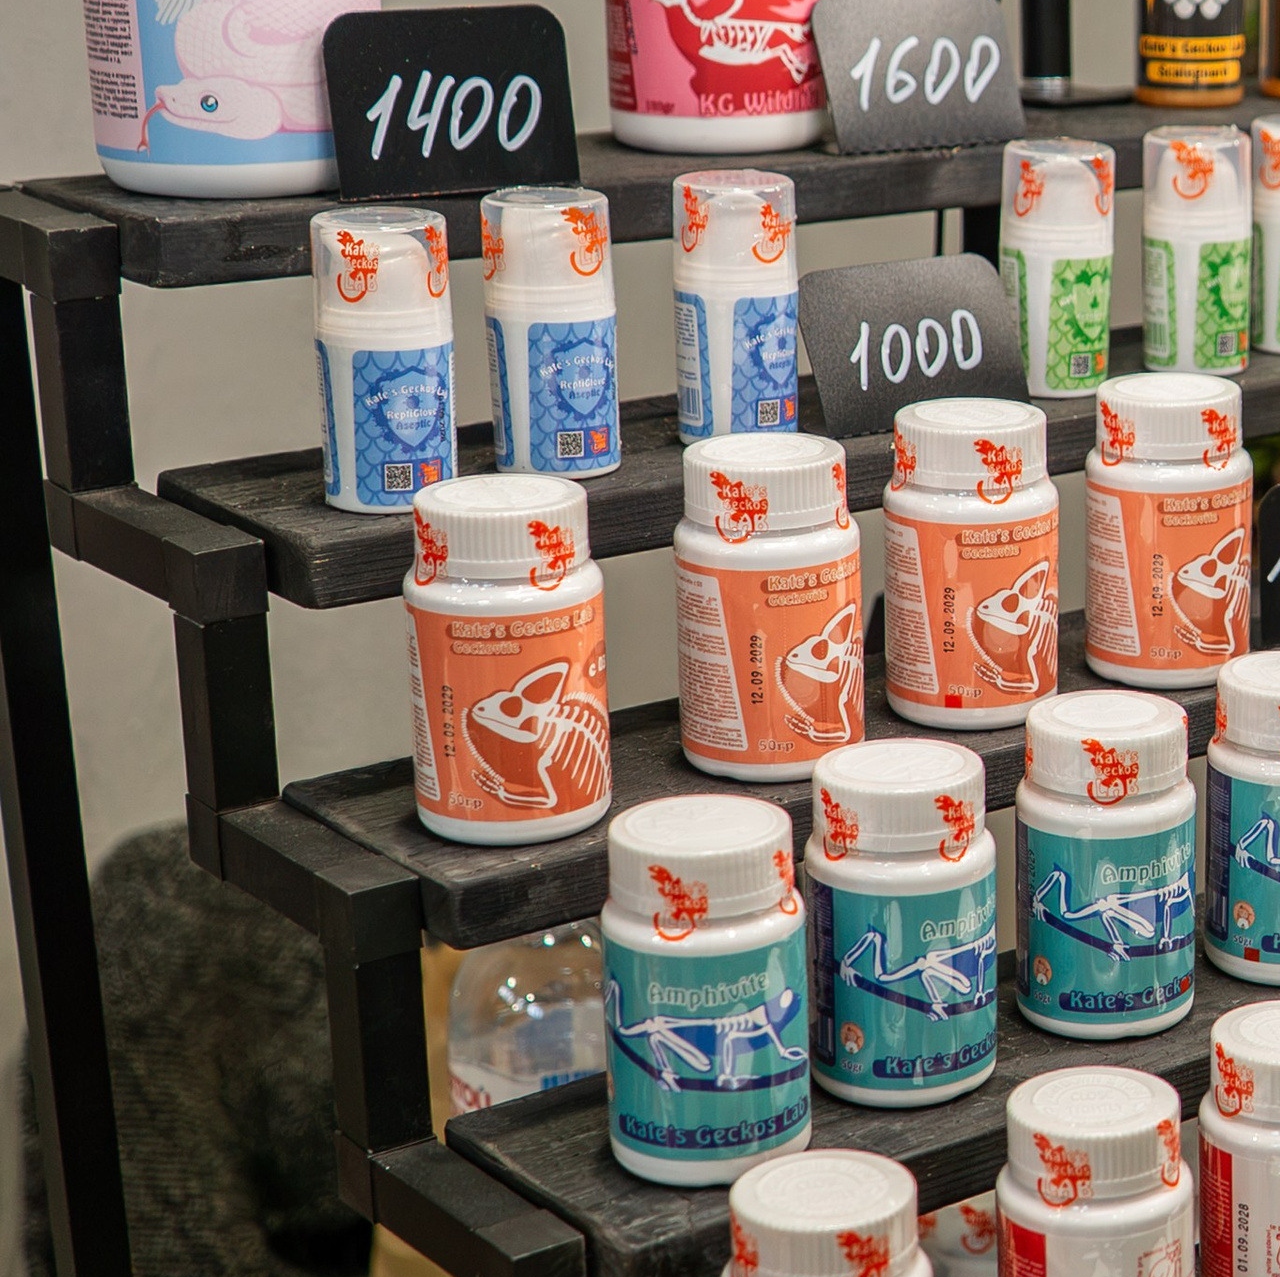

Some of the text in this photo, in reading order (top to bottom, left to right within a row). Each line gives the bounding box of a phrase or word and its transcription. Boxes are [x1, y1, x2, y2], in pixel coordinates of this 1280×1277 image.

[850, 35, 1001, 112] 1600
[701, 93, 735, 115] KG
[366, 70, 543, 161] 1400
[344, 257, 379, 271] Geckos
[344, 272, 378, 293] LAB
[849, 307, 983, 392] 1000
[539, 355, 605, 377] Kate's Geckos
[560, 377, 605, 390] ReptiGlove
[365, 384, 436, 407] Kate's Geckos
[568, 389, 601, 401] Aseptic
[387, 407, 438, 420] ReptiGlove
[396, 419, 432, 432] Aseptic
[987, 445, 1023, 462] Kate's
[987, 460, 1023, 474] Geckos
[722, 484, 768, 498] Kate's
[722, 497, 769, 512] Geckos
[1163, 495, 1209, 513] Kate's
[722, 512, 769, 533] LAB
[961, 527, 1010, 546] Kate's
[961, 545, 1020, 560] Geckovite
[767, 571, 818, 592] Kate's
[1152, 553, 1164, 618] 12.09.2029
[768, 589, 829, 607] Geckovite
[451, 619, 506, 640] Kate's
[511, 615, 571, 638] Geckos
[943, 587, 955, 654] 12.09.2029
[751, 634, 763, 705] 12.09.2029
[444, 684, 455, 759] 12.09.2029
[758, 738, 795, 755] 50гр
[1094, 750, 1139, 764] Kate's
[1094, 763, 1139, 777] Geckos
[1094, 777, 1139, 797] LAB
[1101, 841, 1192, 887] Amphivite
[920, 892, 996, 943] Amphivi
[647, 971, 769, 1011] Amphivite
[1070, 990, 1134, 1010] Kate's
[886, 1028, 996, 1075] Kate's Gecko
[1218, 1093, 1255, 1114] LAB
[624, 1097, 809, 1146] Kate's Geckos Lab
[1041, 1178, 1093, 1199] LAB
[1238, 1203, 1250, 1273] 01.09.2028
